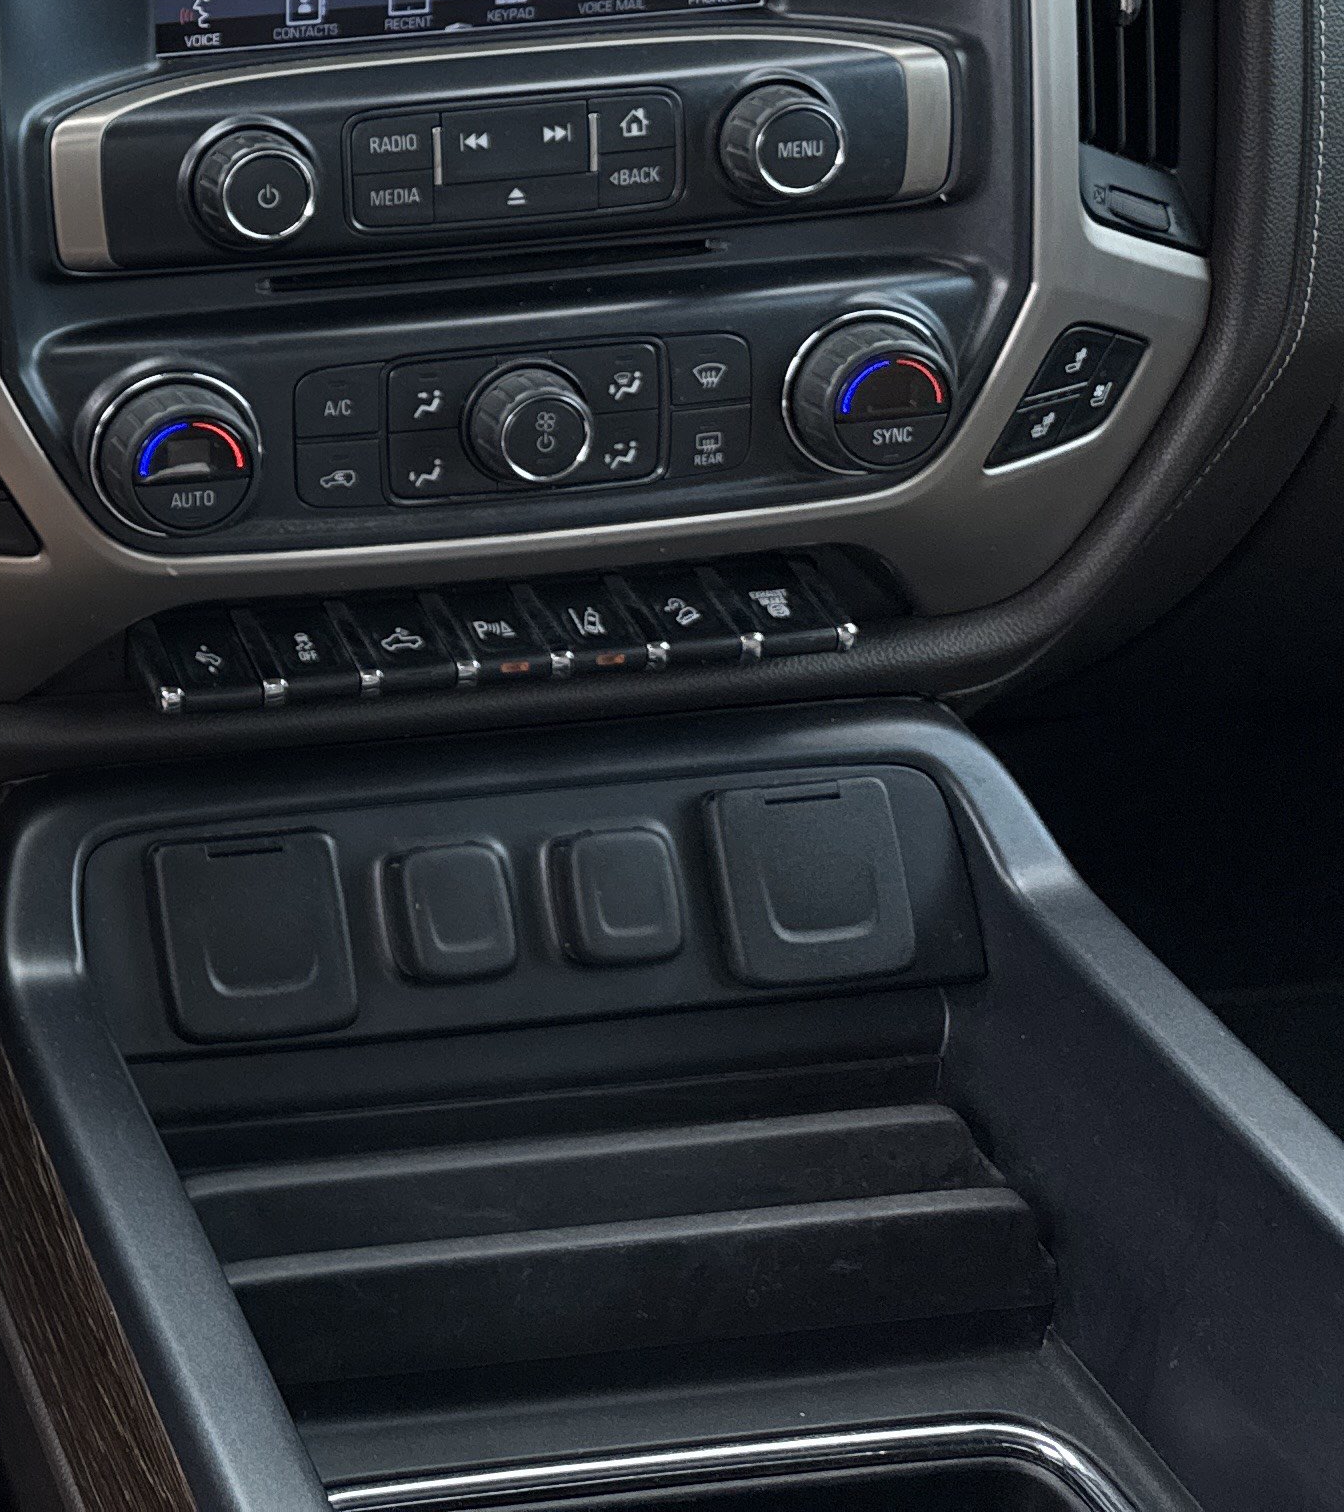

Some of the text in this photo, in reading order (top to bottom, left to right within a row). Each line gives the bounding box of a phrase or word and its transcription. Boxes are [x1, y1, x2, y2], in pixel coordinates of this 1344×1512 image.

[384, 15, 434, 31] RECENT
[486, 6, 536, 23] KEYPAD
[184, 32, 222, 48] VOICE
[273, 23, 339, 41] CONTACTS
[369, 133, 418, 154] RADIO
[777, 139, 824, 159] MENU
[619, 165, 661, 186] BACK
[370, 187, 421, 207] MEDIA
[323, 399, 352, 419] A/C
[871, 426, 914, 445] SYNC
[693, 450, 724, 466] REAR
[170, 490, 215, 510] AUTO
